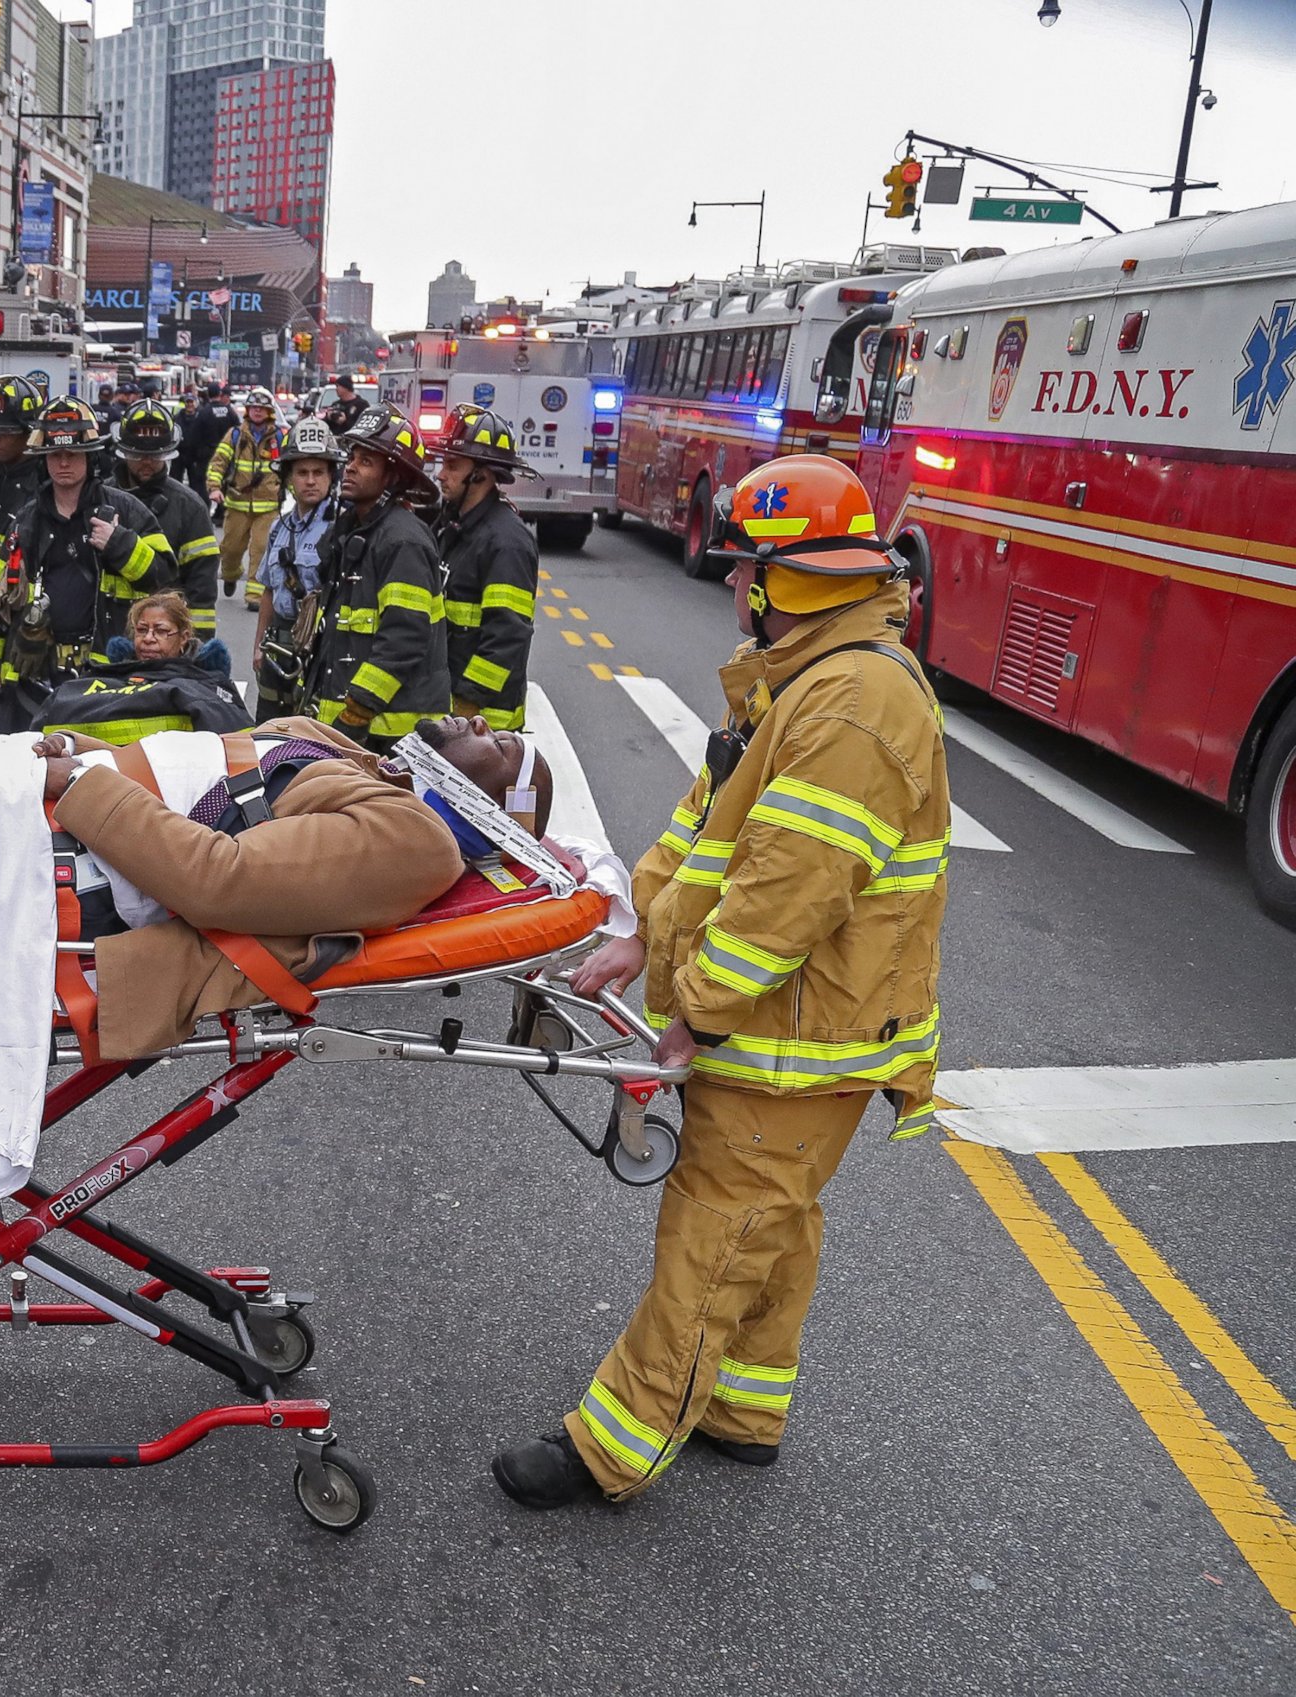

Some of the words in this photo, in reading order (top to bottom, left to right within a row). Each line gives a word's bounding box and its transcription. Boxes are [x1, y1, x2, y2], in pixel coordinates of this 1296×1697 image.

[1003, 204, 1016, 217] 4
[1024, 204, 1051, 219] Av
[85, 288, 181, 310] BARCLS
[187, 290, 263, 312] CETER
[1031, 369, 1194, 419] F.D.N.Y.
[357, 415, 380, 428] 226
[300, 429, 325, 441] 226
[520, 434, 556, 448] ICE
